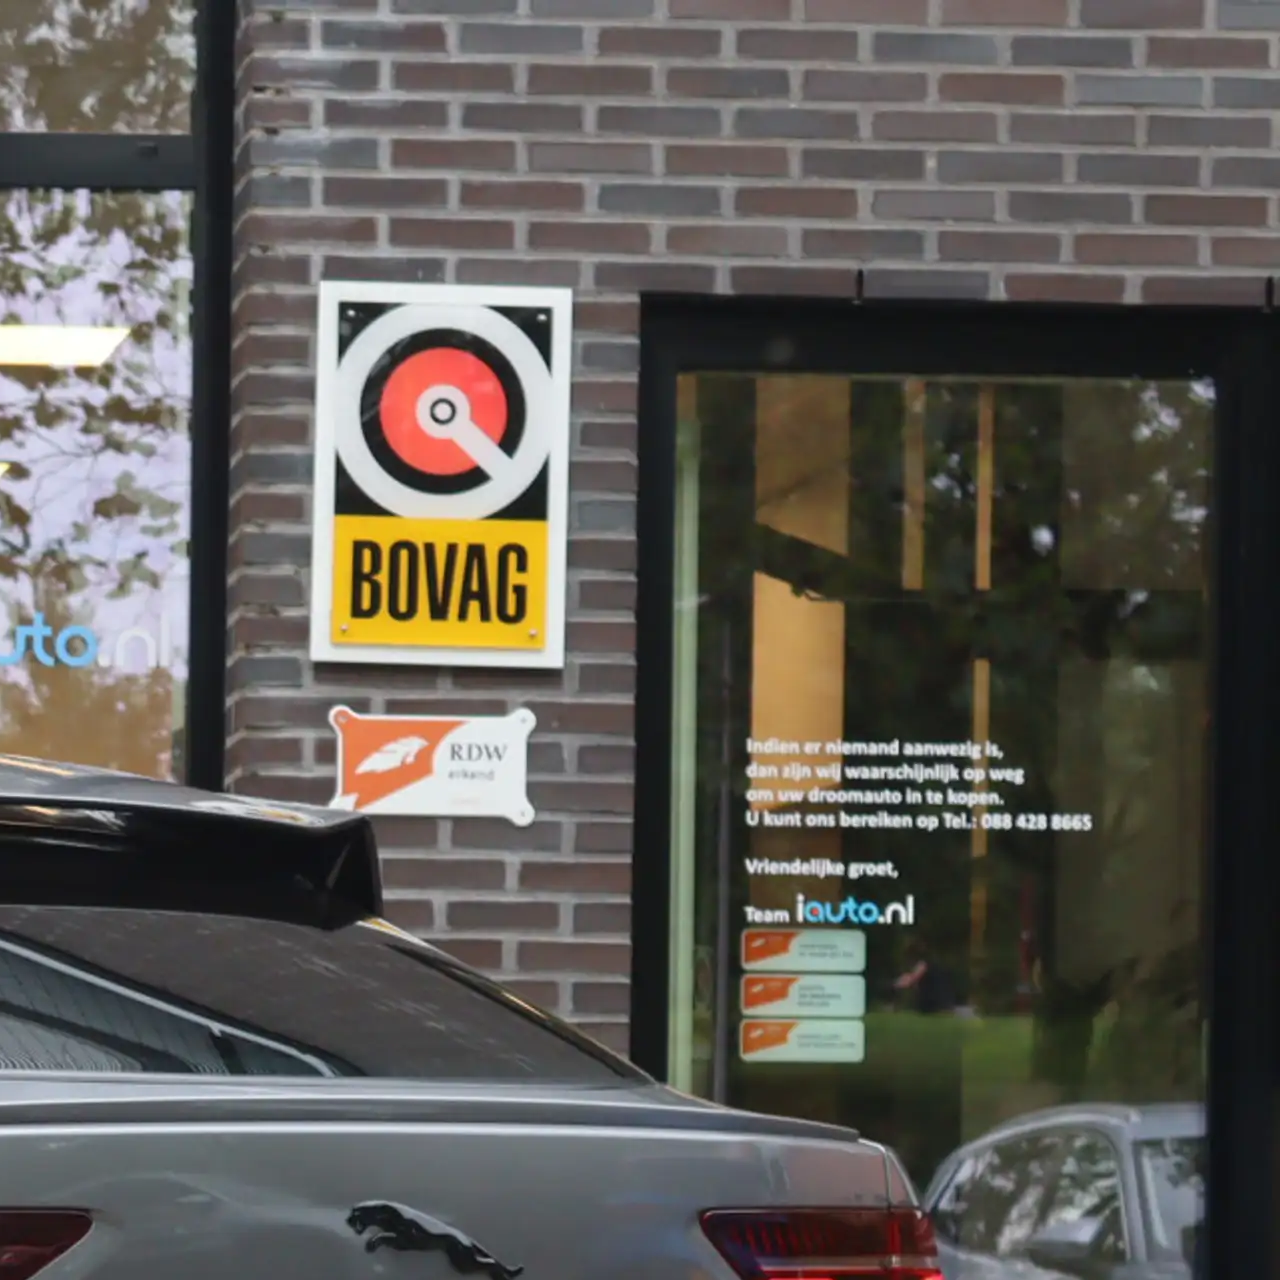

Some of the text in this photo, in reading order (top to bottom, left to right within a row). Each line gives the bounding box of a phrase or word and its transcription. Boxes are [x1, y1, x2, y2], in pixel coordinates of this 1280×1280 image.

[351, 539, 529, 624] BOVAG
[450, 743, 507, 762] RDW
[746, 738, 1004, 760] Indien er niemand aanwezig is,
[745, 762, 1025, 785] dan zijn wij waarschijnlijk op weg
[745, 785, 1005, 808] om uw droomauto in te kopen.
[745, 811, 759, 826] U
[764, 810, 802, 827] kunt
[805, 813, 836, 828] ons
[840, 811, 913, 829] bereiken
[916, 814, 939, 832] op
[981, 813, 1013, 830] 088
[1015, 813, 1048, 831] 428
[744, 858, 899, 879] Vriendelijke groet,
[743, 893, 914, 925] Team iauto.nl
